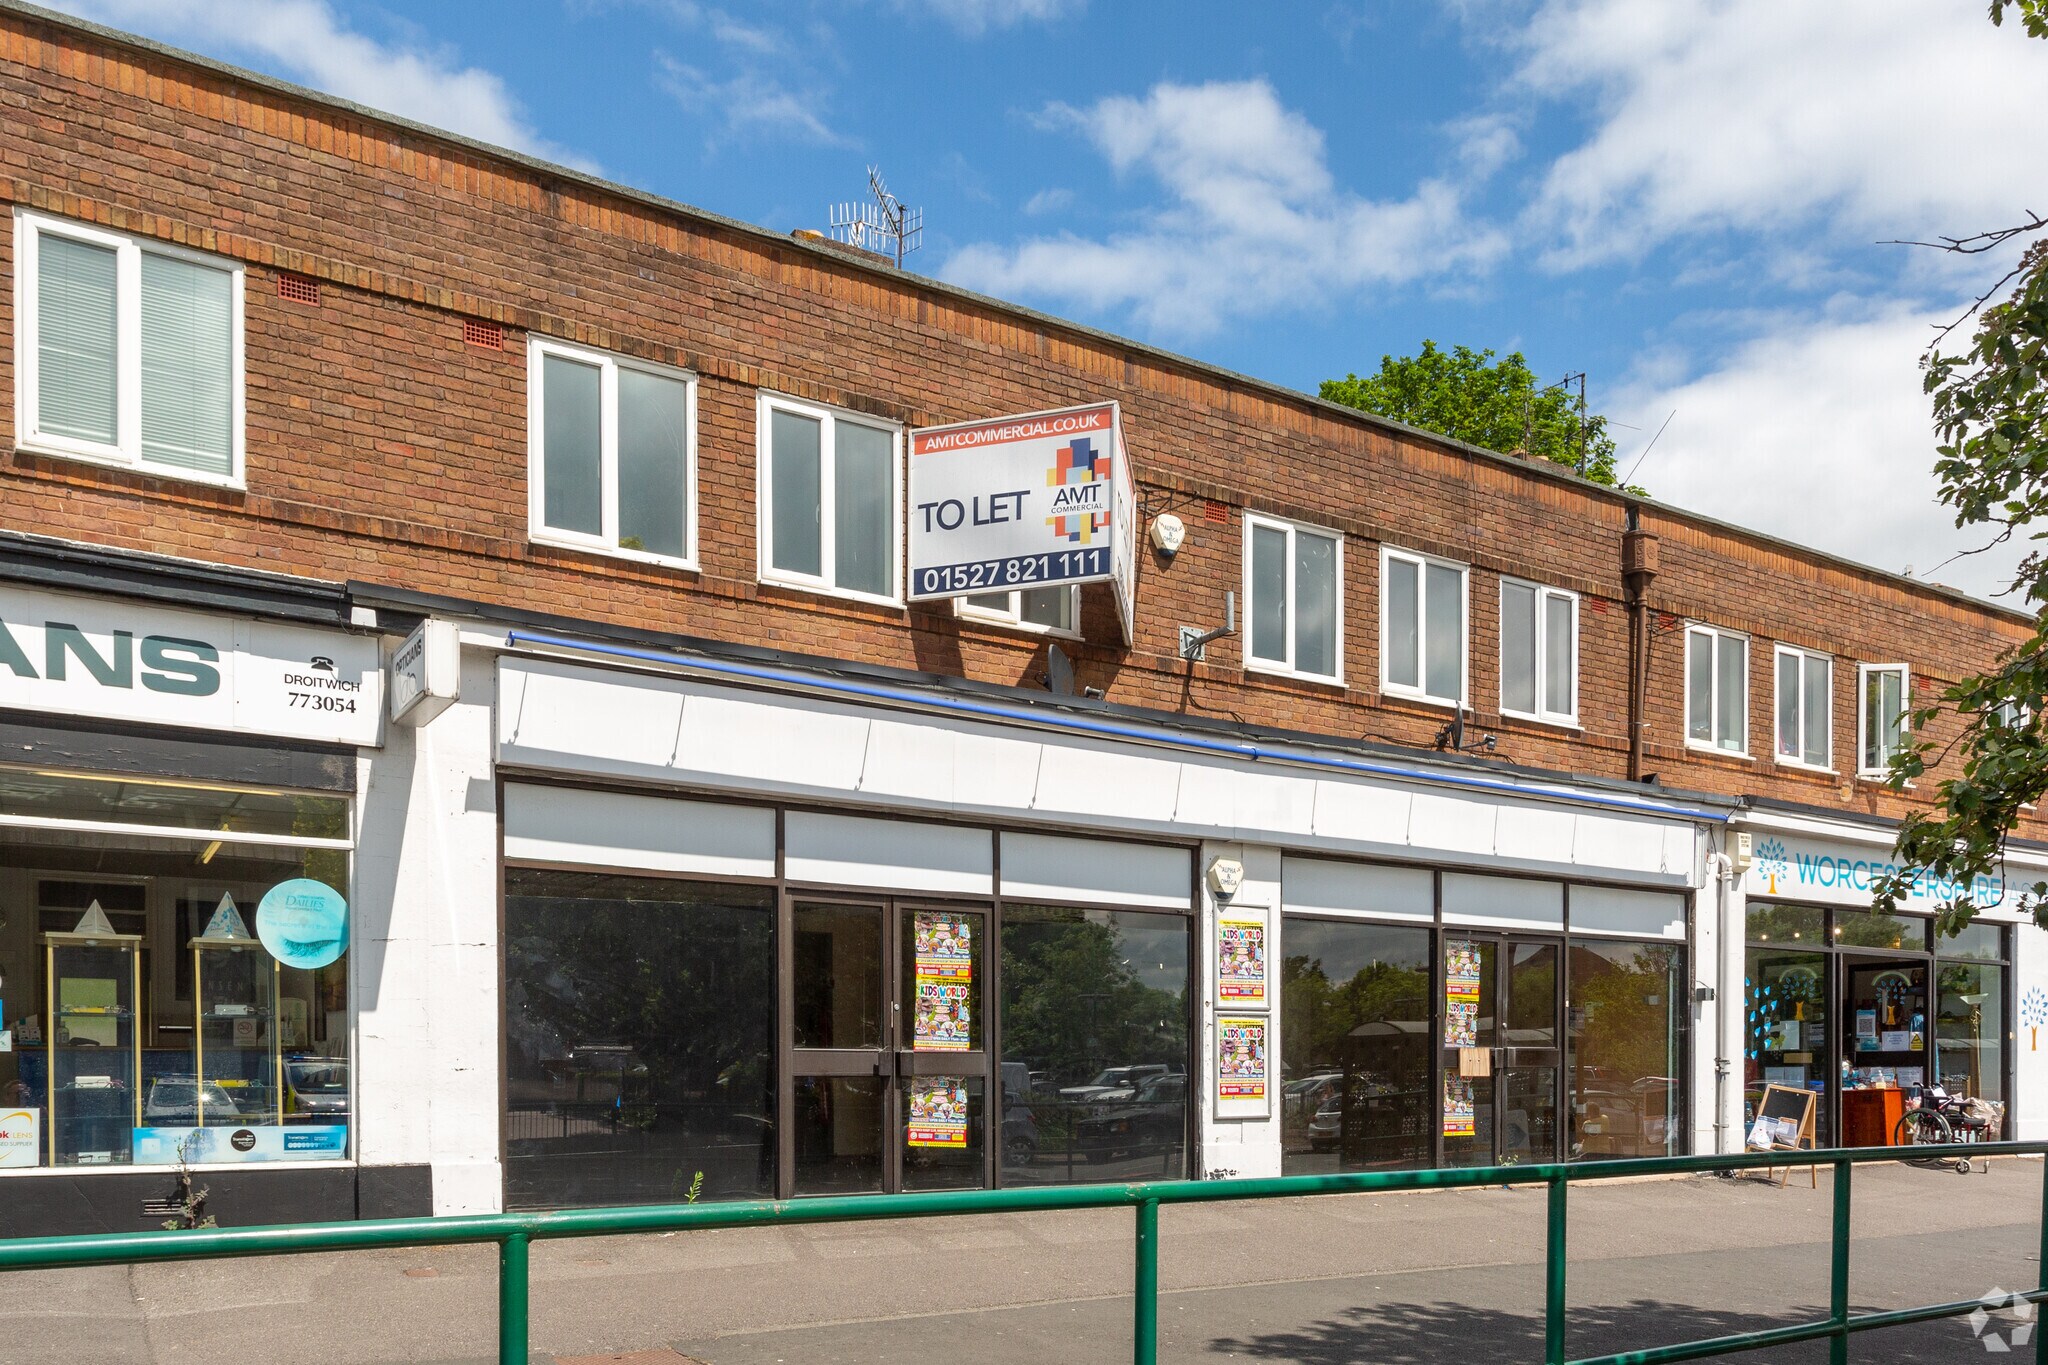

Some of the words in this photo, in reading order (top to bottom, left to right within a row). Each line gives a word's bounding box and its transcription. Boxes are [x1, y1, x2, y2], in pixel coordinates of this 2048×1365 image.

[925, 413, 1100, 450] AMTCOMMERCIAL.CO.UK
[1053, 484, 1102, 507] AMT
[918, 499, 966, 532] TO
[973, 490, 1031, 526] LET
[1051, 503, 1103, 514] COMMERCIAL
[923, 562, 1000, 592] 01527
[1006, 556, 1049, 583] 821
[1059, 550, 1100, 576] 111
[396, 638, 422, 677] OPTICIANS
[284, 674, 360, 692] DROITWICH
[288, 692, 357, 713] 773054
[1223, 929, 1239, 940] KIDS
[1240, 930, 1261, 941] WORLD
[920, 985, 937, 997] KIDS
[939, 986, 967, 998] WORLD
[1223, 1028, 1239, 1038] KIDS
[1240, 1029, 1262, 1039] WORLD
